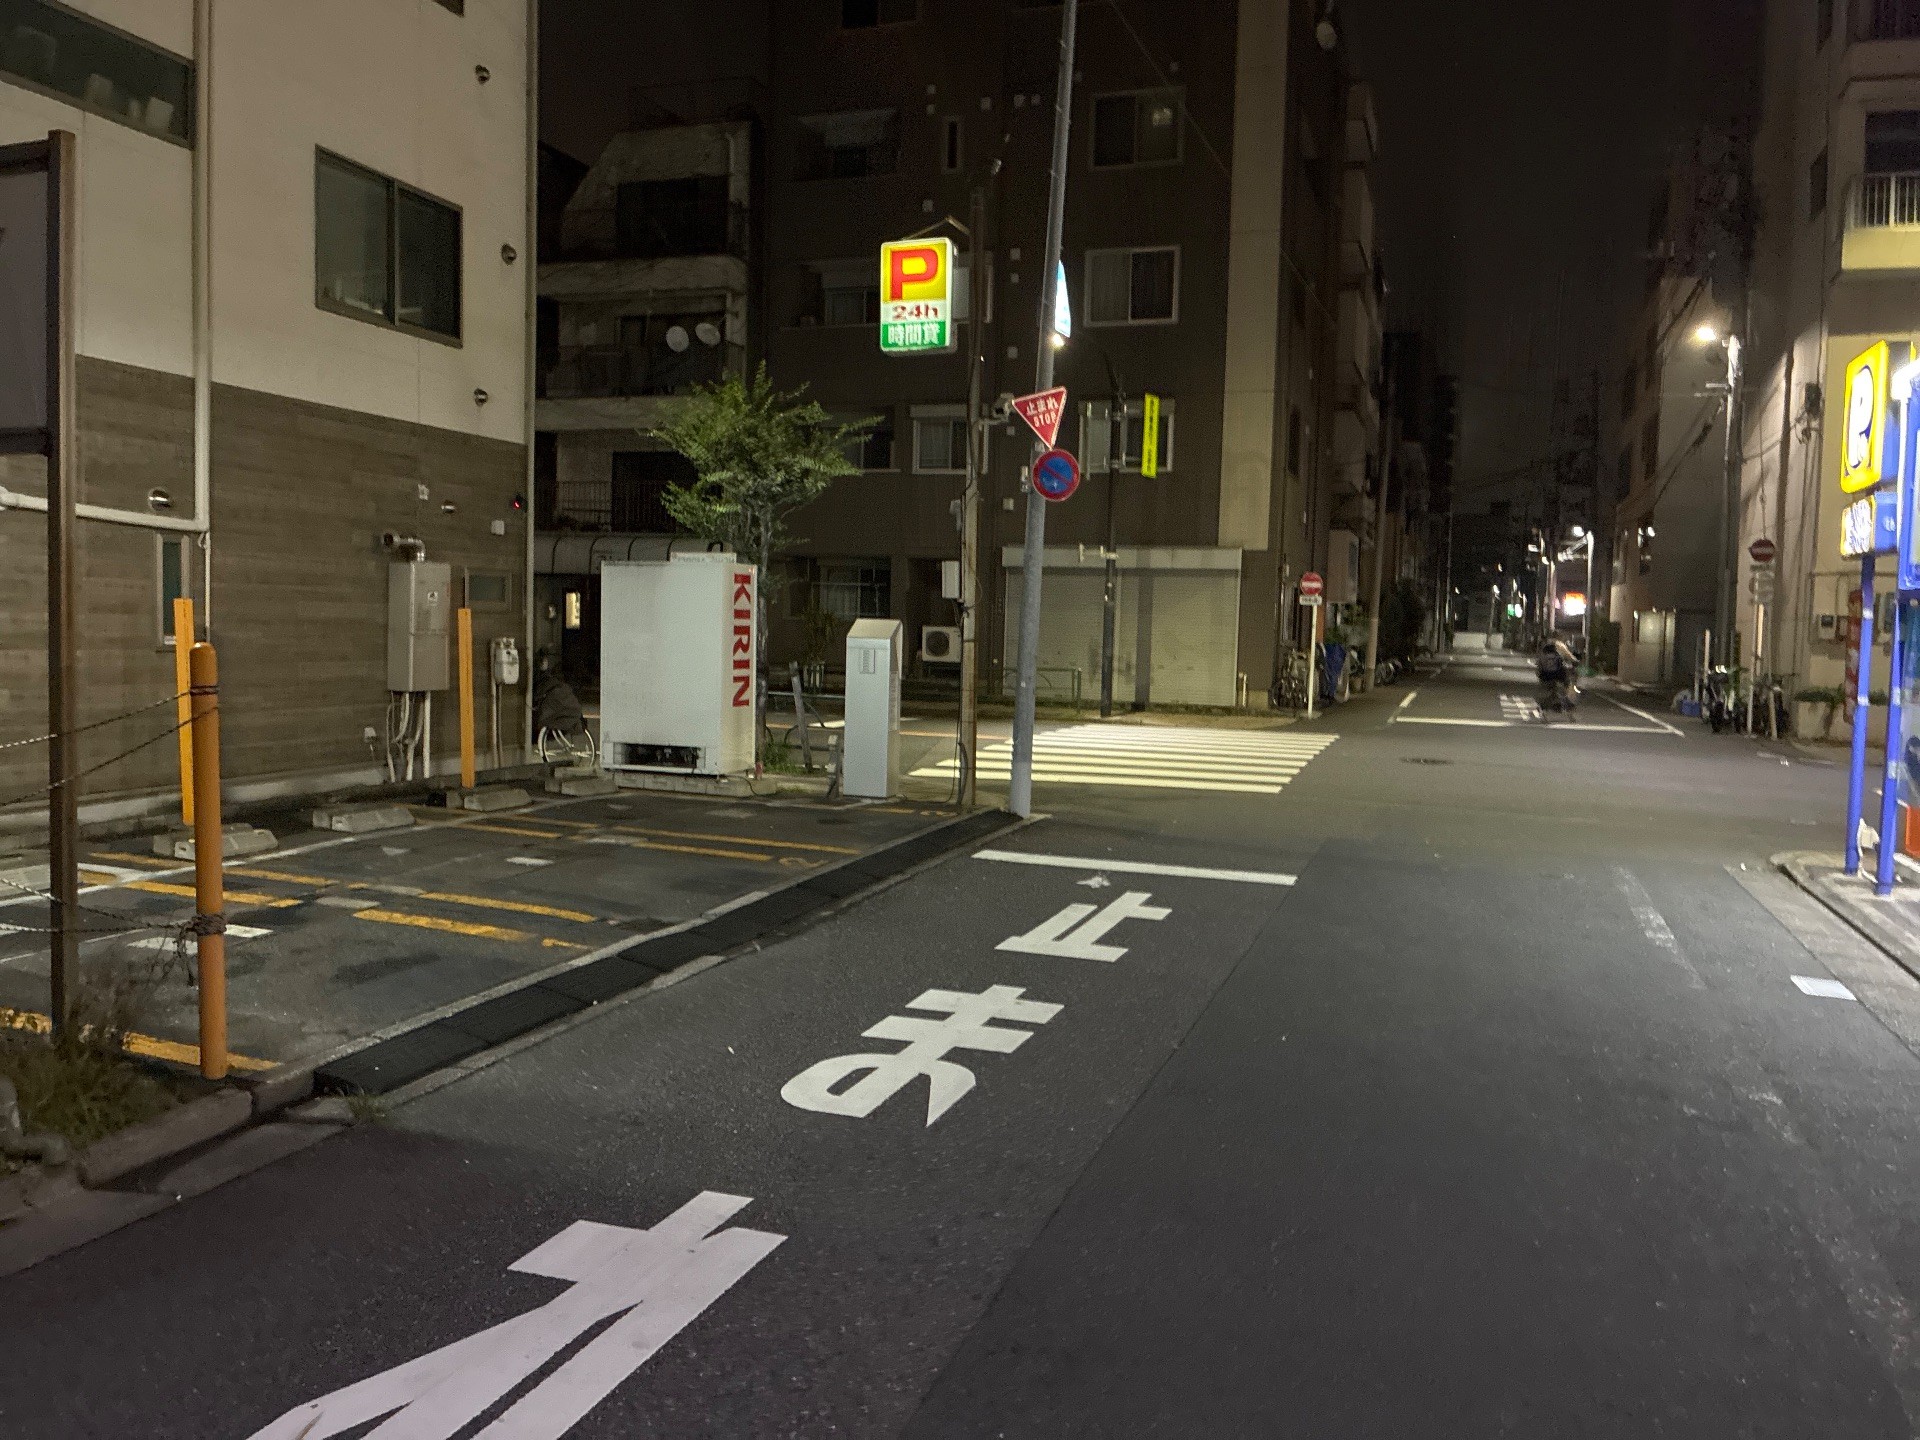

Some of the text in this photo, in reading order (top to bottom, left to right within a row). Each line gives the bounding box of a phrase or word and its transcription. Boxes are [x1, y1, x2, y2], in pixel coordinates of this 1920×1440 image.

[891, 249, 938, 300] P
[892, 304, 938, 320] 24h
[888, 322, 940, 346] 時間貸
[1027, 397, 1059, 415] 止まれ
[1034, 412, 1057, 427] STOP
[732, 573, 751, 707] KIRIN
